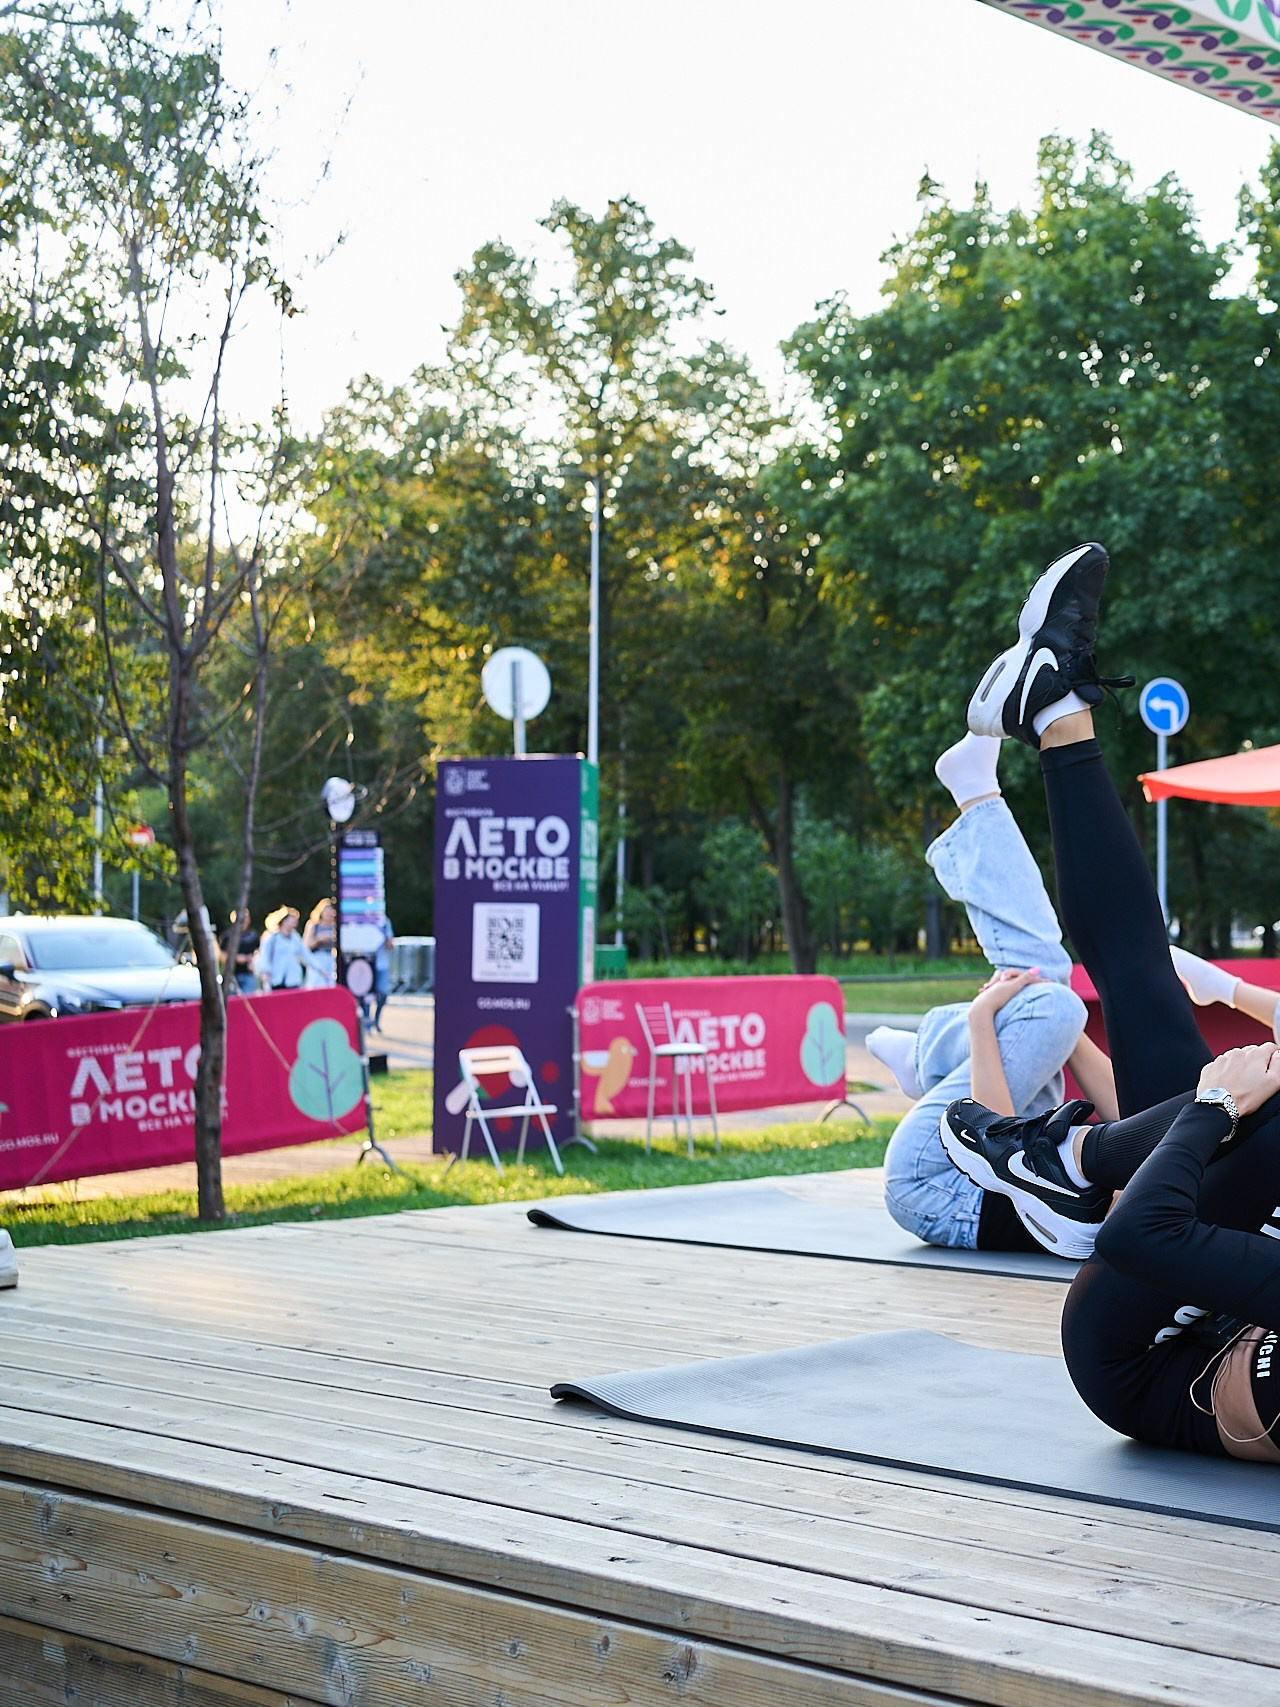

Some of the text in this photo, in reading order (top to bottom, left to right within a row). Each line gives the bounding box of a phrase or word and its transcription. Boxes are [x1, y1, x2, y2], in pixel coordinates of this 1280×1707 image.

[444, 815, 571, 858] ЛЕТО
[443, 857, 570, 880] В МОСКВЕ
[673, 1012, 766, 1050] ЛЕТО
[690, 1049, 766, 1075] МОСКВЕ
[70, 1103, 92, 1126] В
[138, 1119, 163, 1132] ВСЕ
